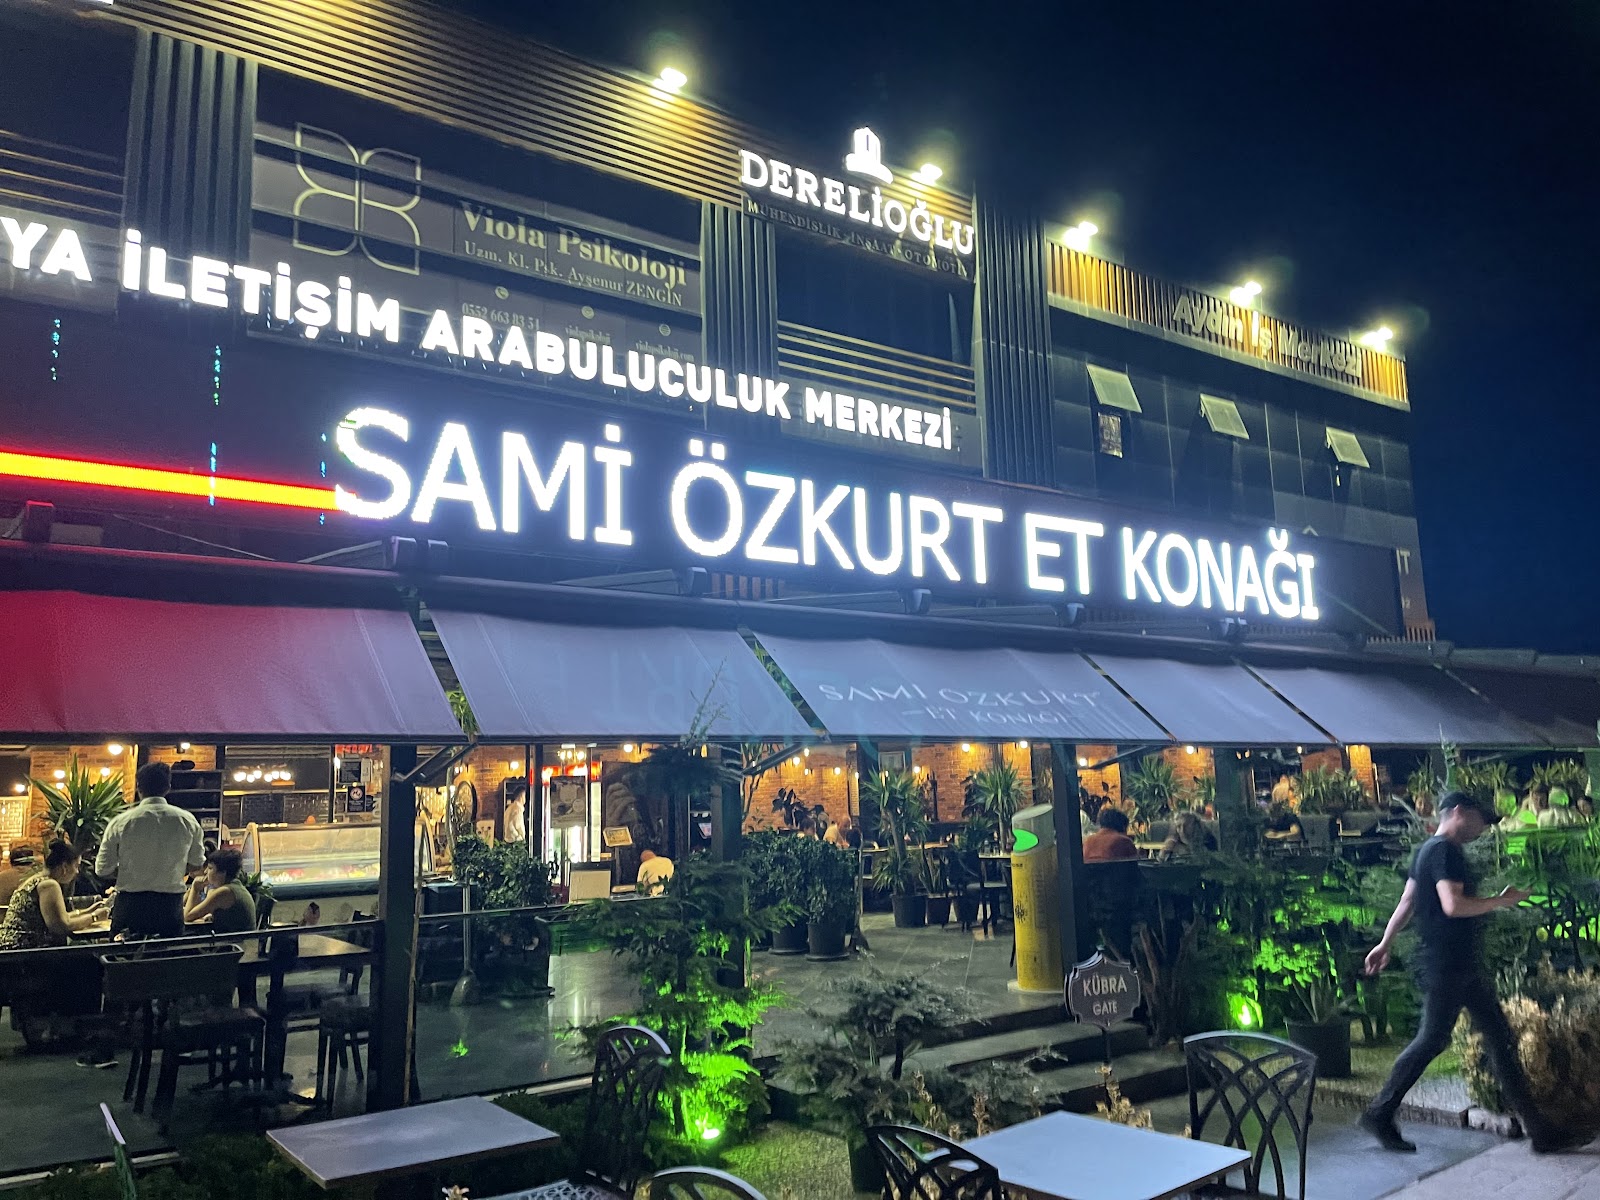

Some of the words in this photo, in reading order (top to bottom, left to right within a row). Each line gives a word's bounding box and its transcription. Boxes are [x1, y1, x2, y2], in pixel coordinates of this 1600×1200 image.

[460, 200, 546, 249] Viola
[557, 226, 687, 290] Psikoloji
[740, 149, 975, 255] DERELİOĞLU
[464, 240, 502, 263] Uzm.
[0, 216, 93, 282] YA
[123, 229, 400, 343] İLETİŞİM
[421, 309, 791, 420] ARABULUCULUK
[805, 387, 954, 451] MERKEZİ
[335, 405, 635, 547] SAMİ
[671, 438, 1004, 586] ÖZKURT
[1024, 511, 1105, 596] ET
[1121, 526, 1321, 622] KONAĞI
[1082, 971, 1128, 997] KÜBRA
[1092, 1000, 1118, 1016] GATE
